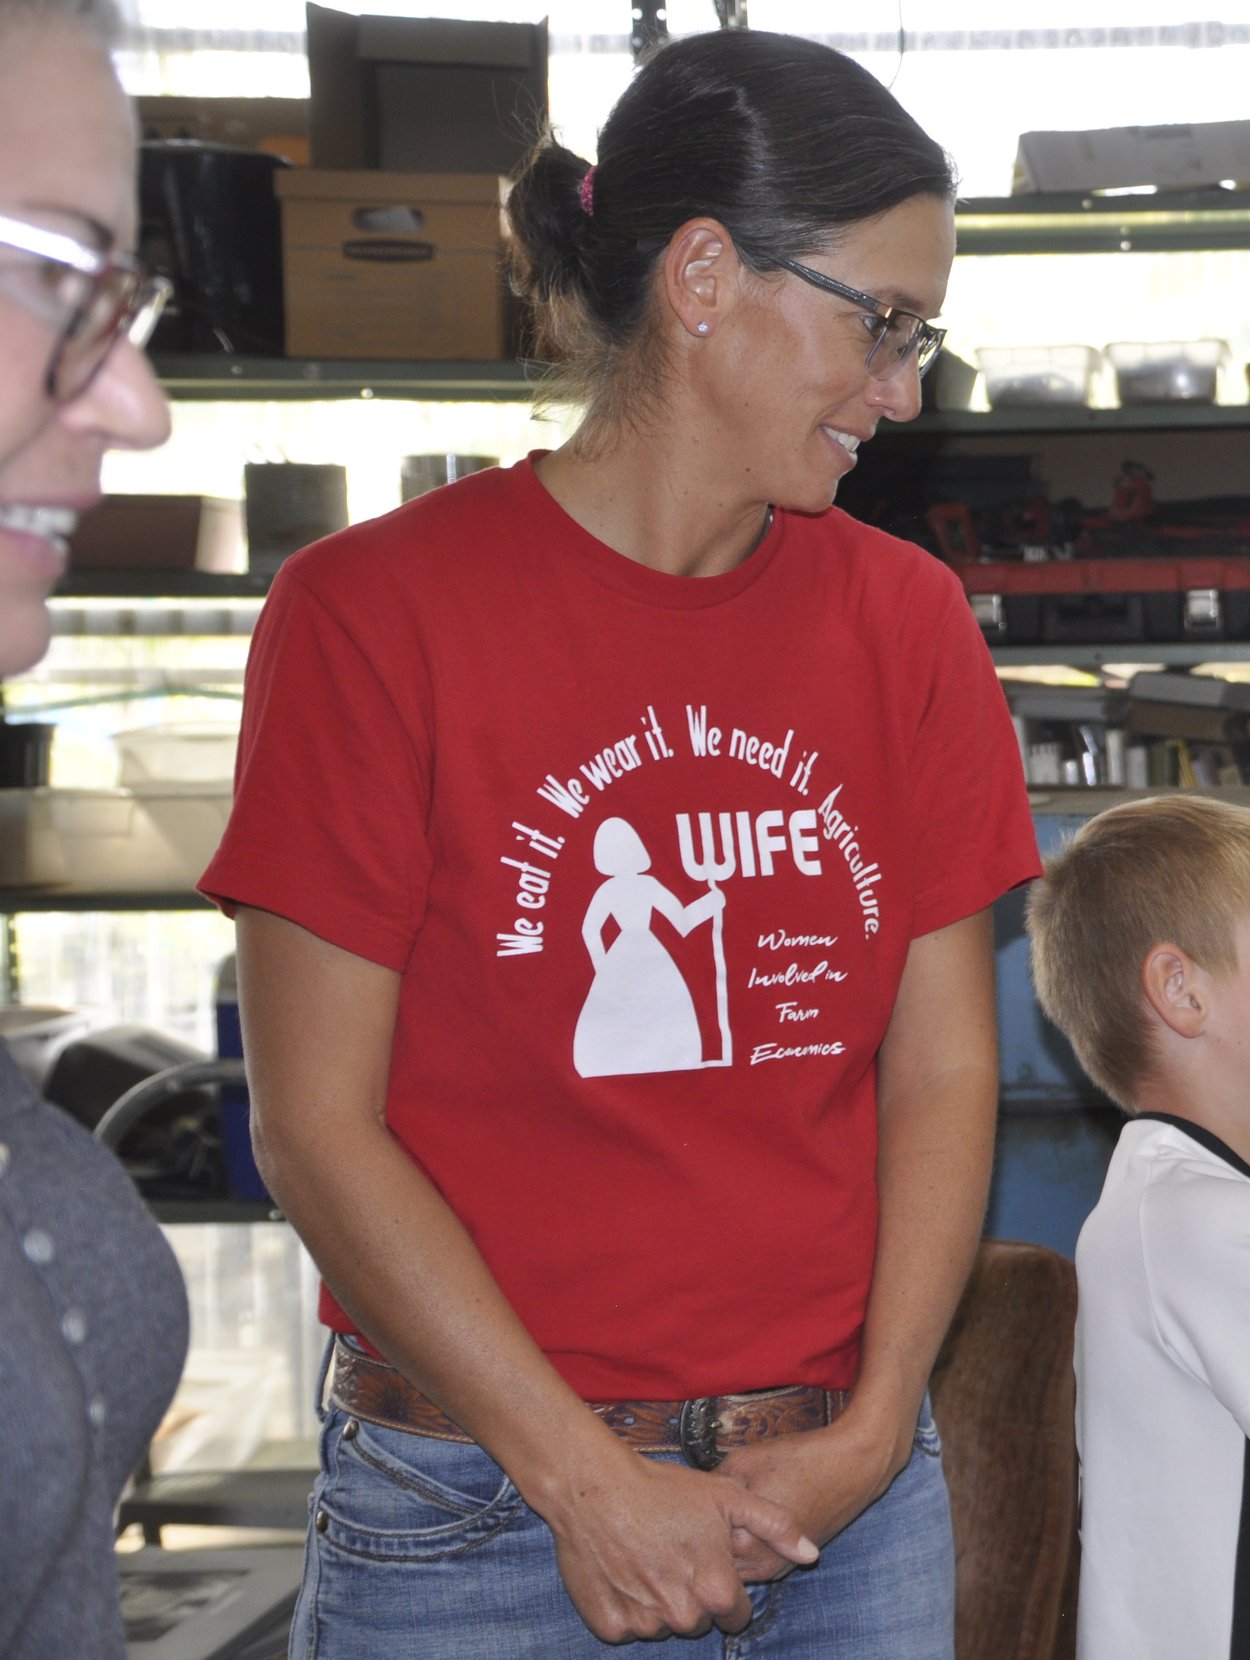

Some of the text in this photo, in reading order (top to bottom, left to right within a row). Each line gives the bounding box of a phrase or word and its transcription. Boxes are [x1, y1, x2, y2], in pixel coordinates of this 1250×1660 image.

[496, 704, 882, 957] We eat it. We wear it. We need it. Agriculture.
[675, 809, 823, 882] WIFE
[757, 929, 838, 951] Women
[748, 960, 849, 989] Involved in
[775, 1001, 819, 1024] Farm
